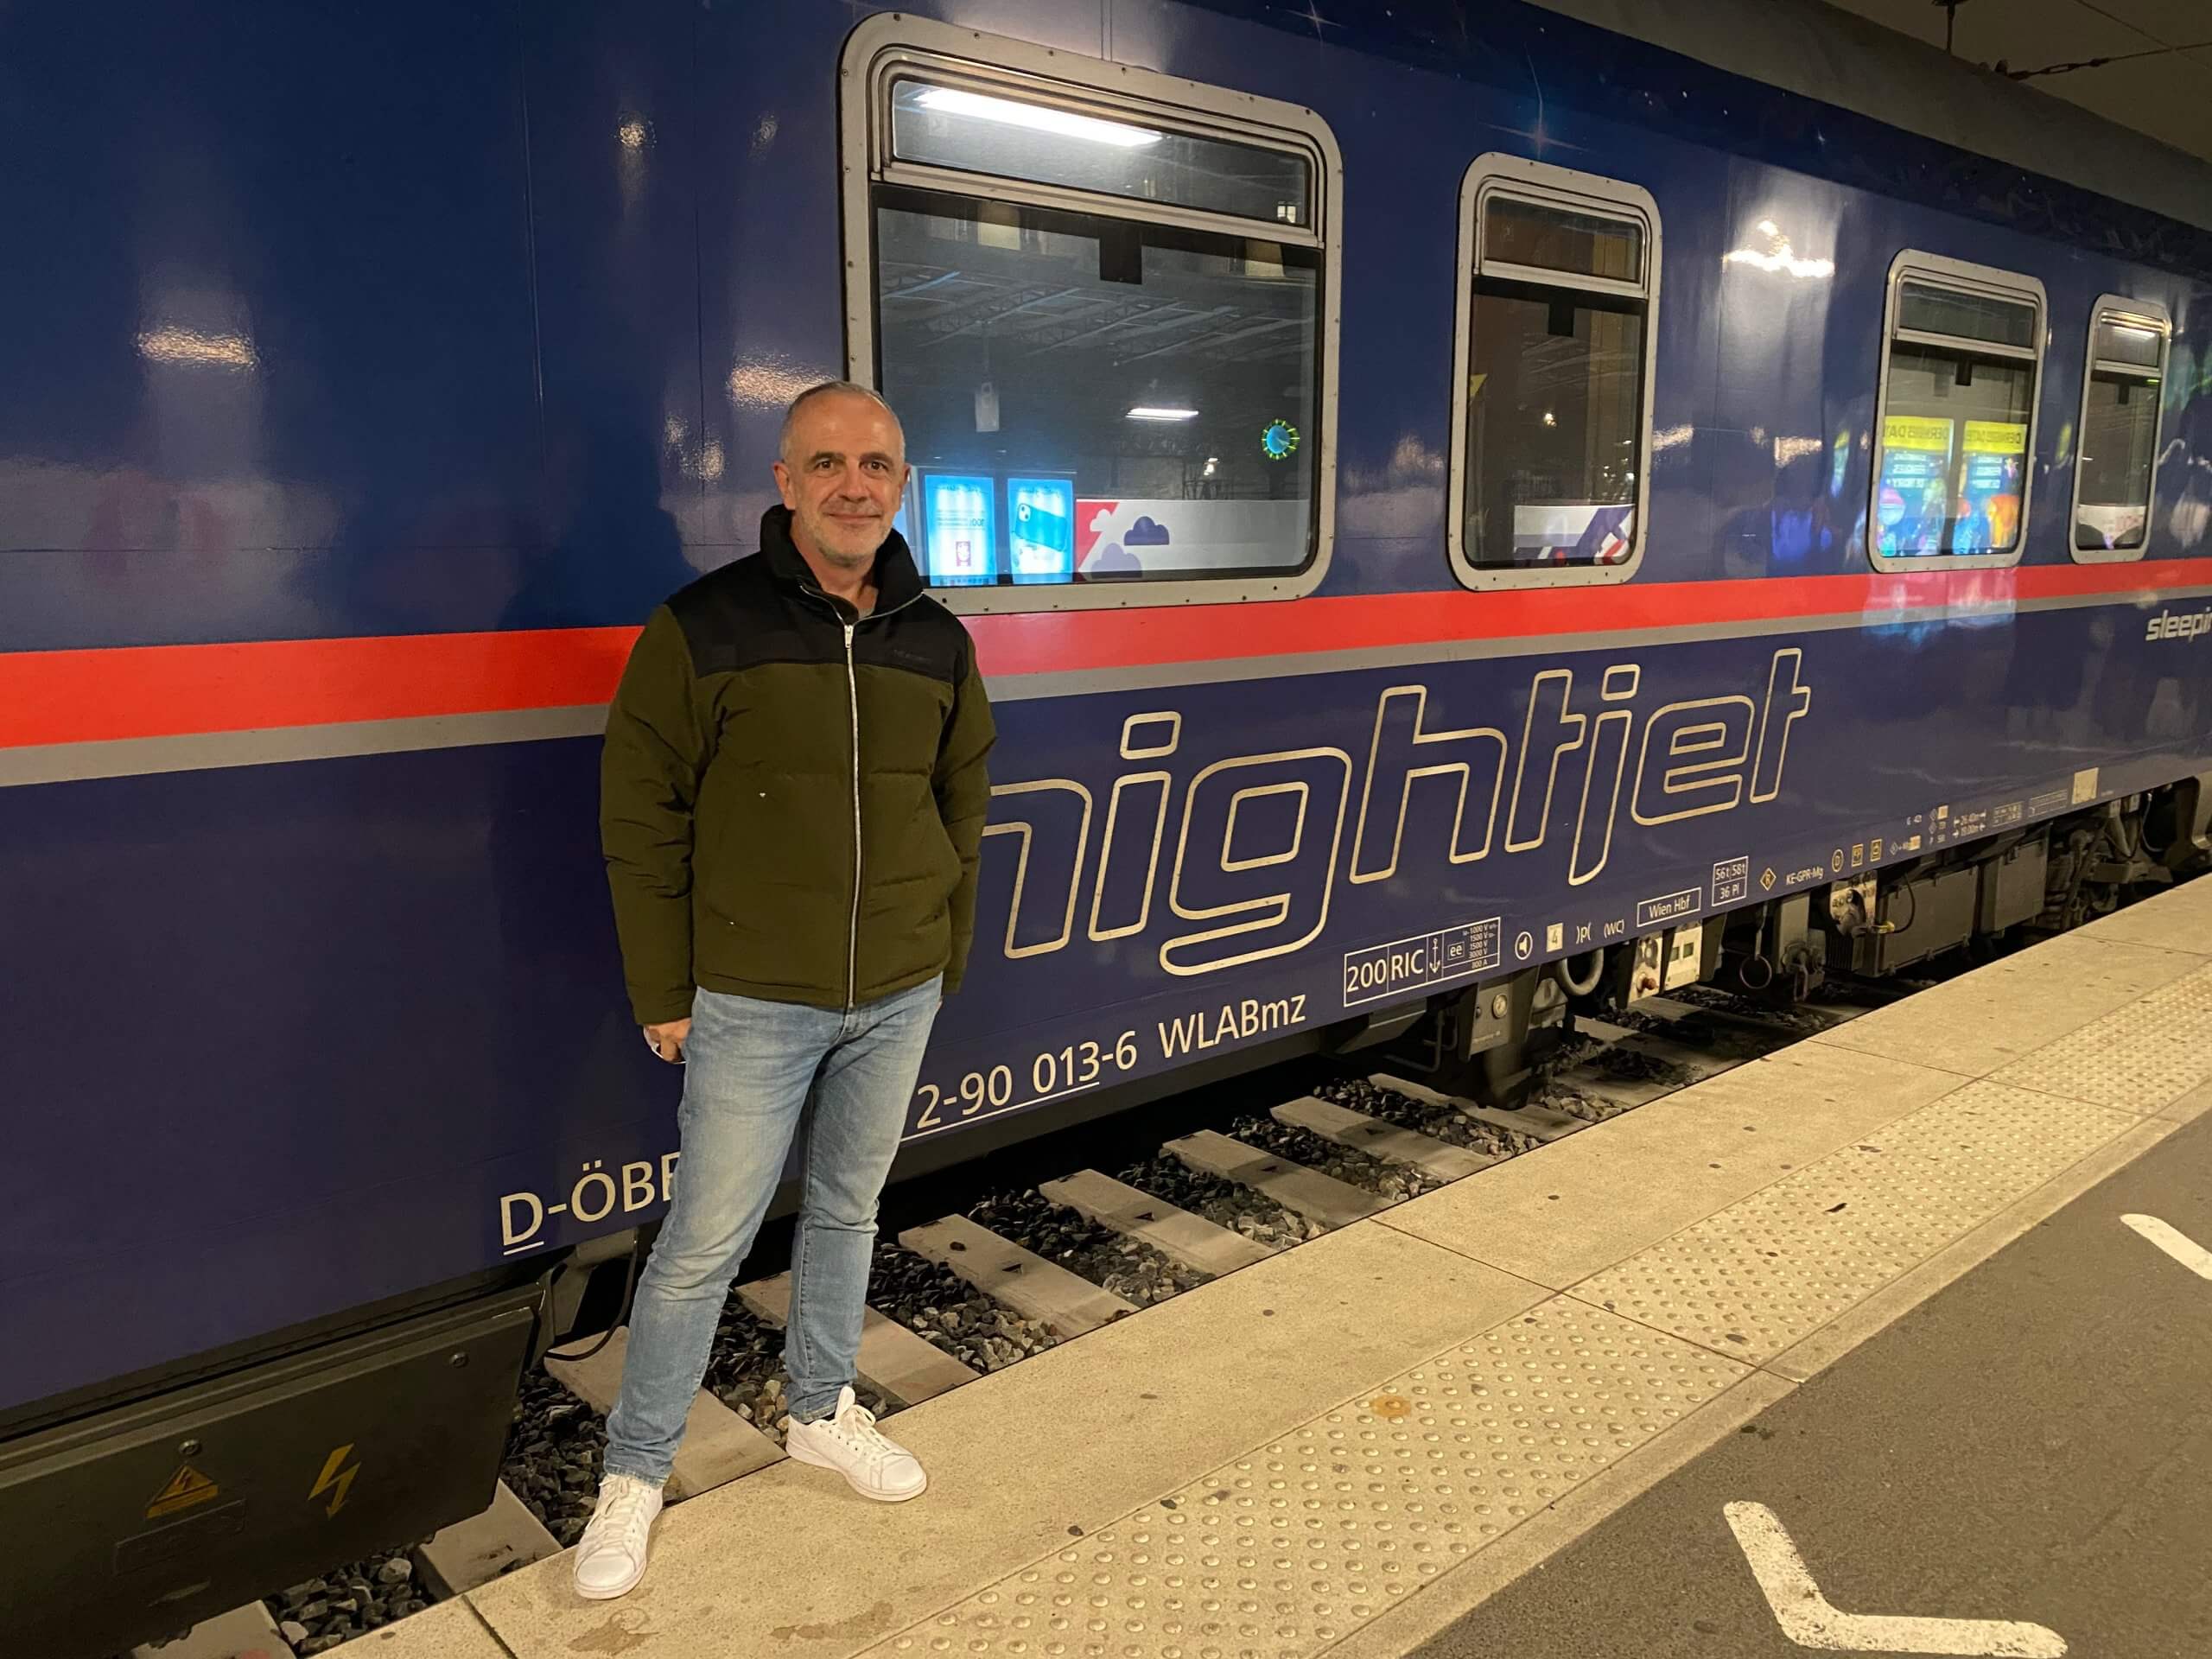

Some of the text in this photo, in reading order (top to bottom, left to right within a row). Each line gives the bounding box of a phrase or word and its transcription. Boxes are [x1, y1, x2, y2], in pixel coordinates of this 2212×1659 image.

[1648, 894, 1690, 918] Wien Hbf
[1450, 944, 1463, 957] ee
[1346, 949, 1425, 994] 200 RIC
[1158, 994, 1307, 1058] WLABmz
